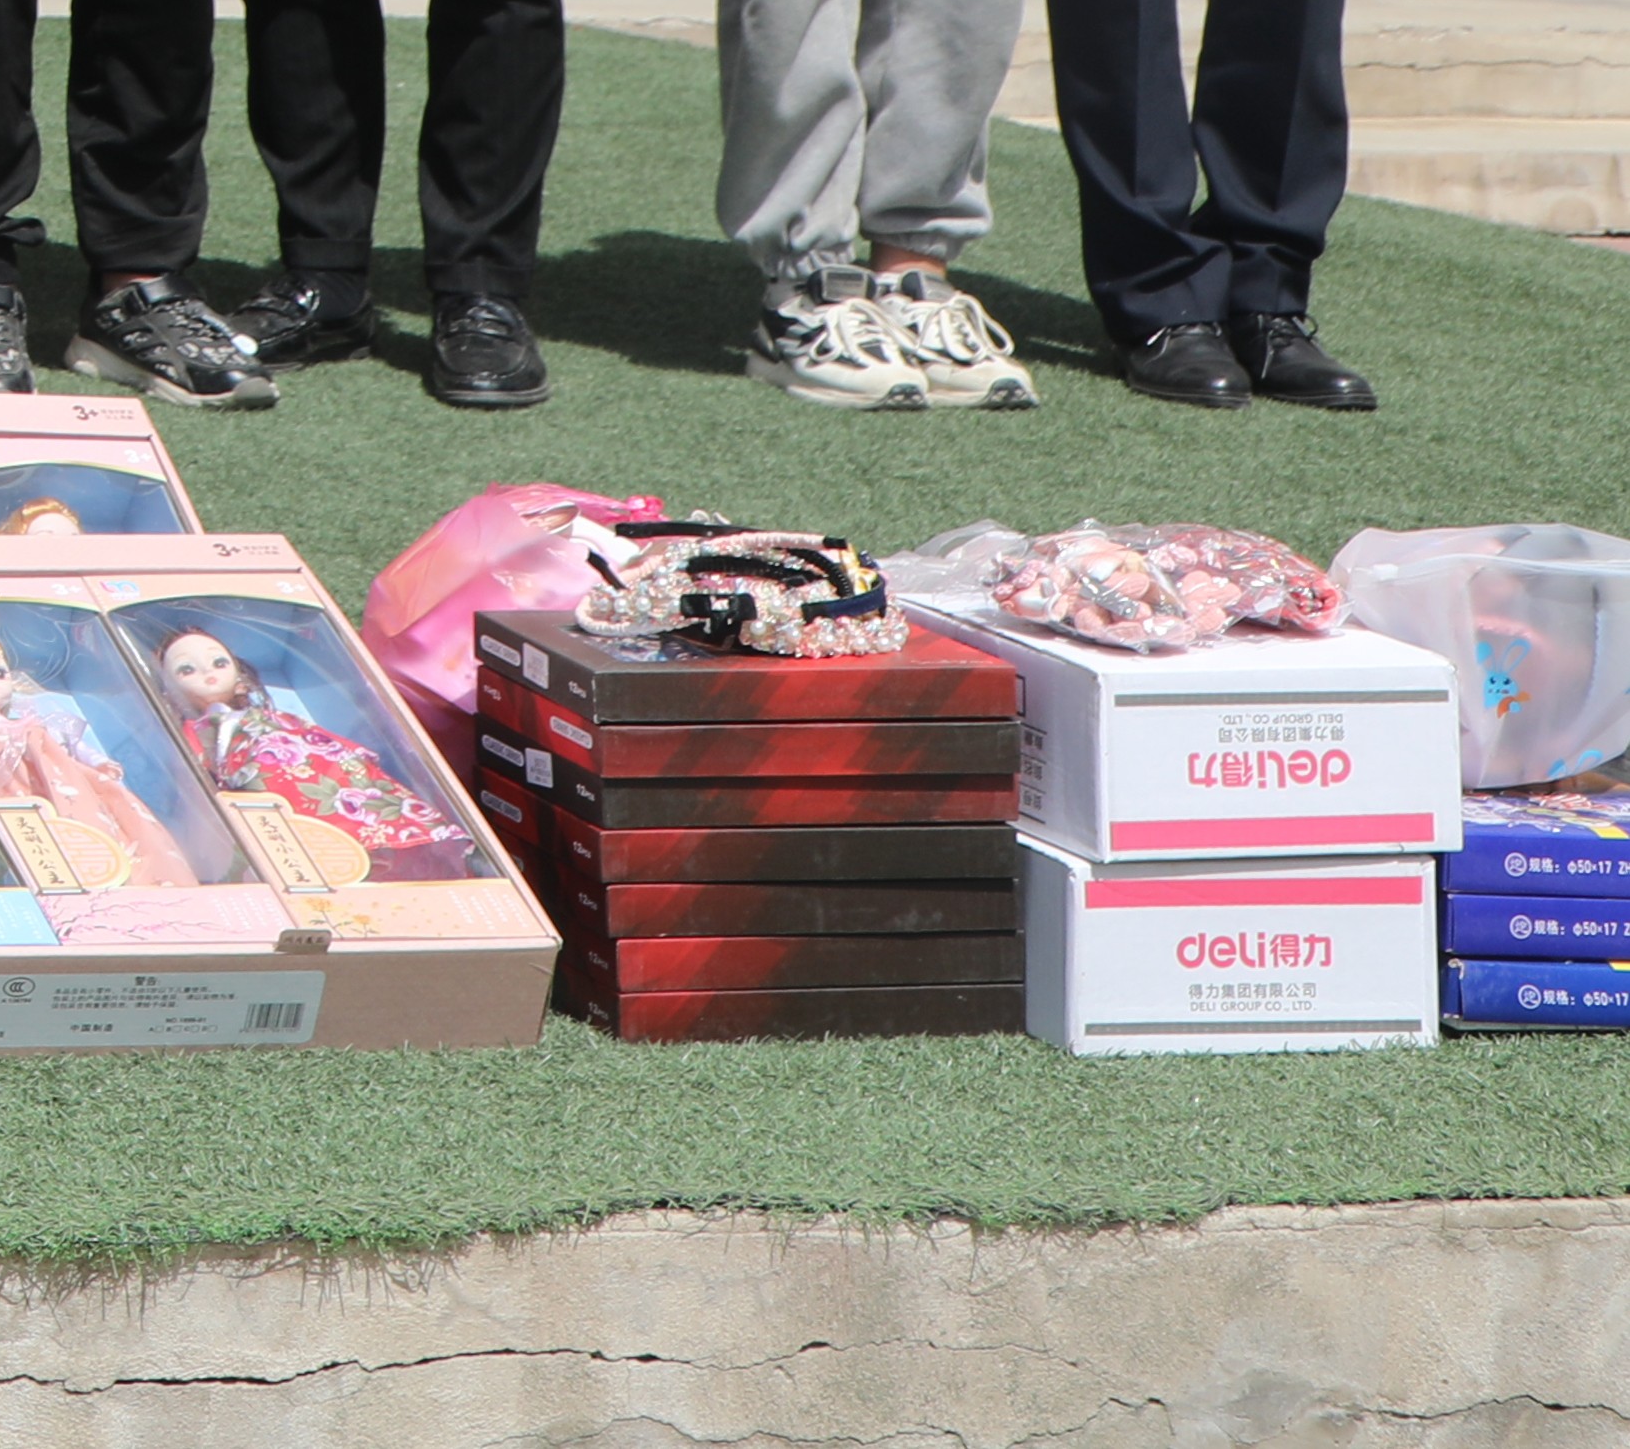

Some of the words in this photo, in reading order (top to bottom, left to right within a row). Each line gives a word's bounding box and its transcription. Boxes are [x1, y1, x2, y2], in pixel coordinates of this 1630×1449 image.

[73, 405, 99, 421] 3+
[213, 543, 242, 558] 3+
[1219, 714, 1243, 725] LTD.
[1272, 714, 1314, 724] GROUP
[1317, 714, 1343, 724] DELI
[1218, 725, 1345, 743] 得力集团有限公司
[17, 812, 71, 888] 灵萌小公主
[259, 808, 314, 885] 灵萌小公主
[1529, 858, 1560, 874] 规格：
[1534, 920, 1565, 936] 规格：
[1188, 982, 1317, 1000] 得力集团有限公司
[1543, 990, 1576, 1006] 规格：
[1190, 1001, 1217, 1012] DELI
[1221, 1001, 1262, 1012] GROUP
[1292, 1001, 1317, 1012] LTD.
[69, 1023, 114, 1033] 中国制造
